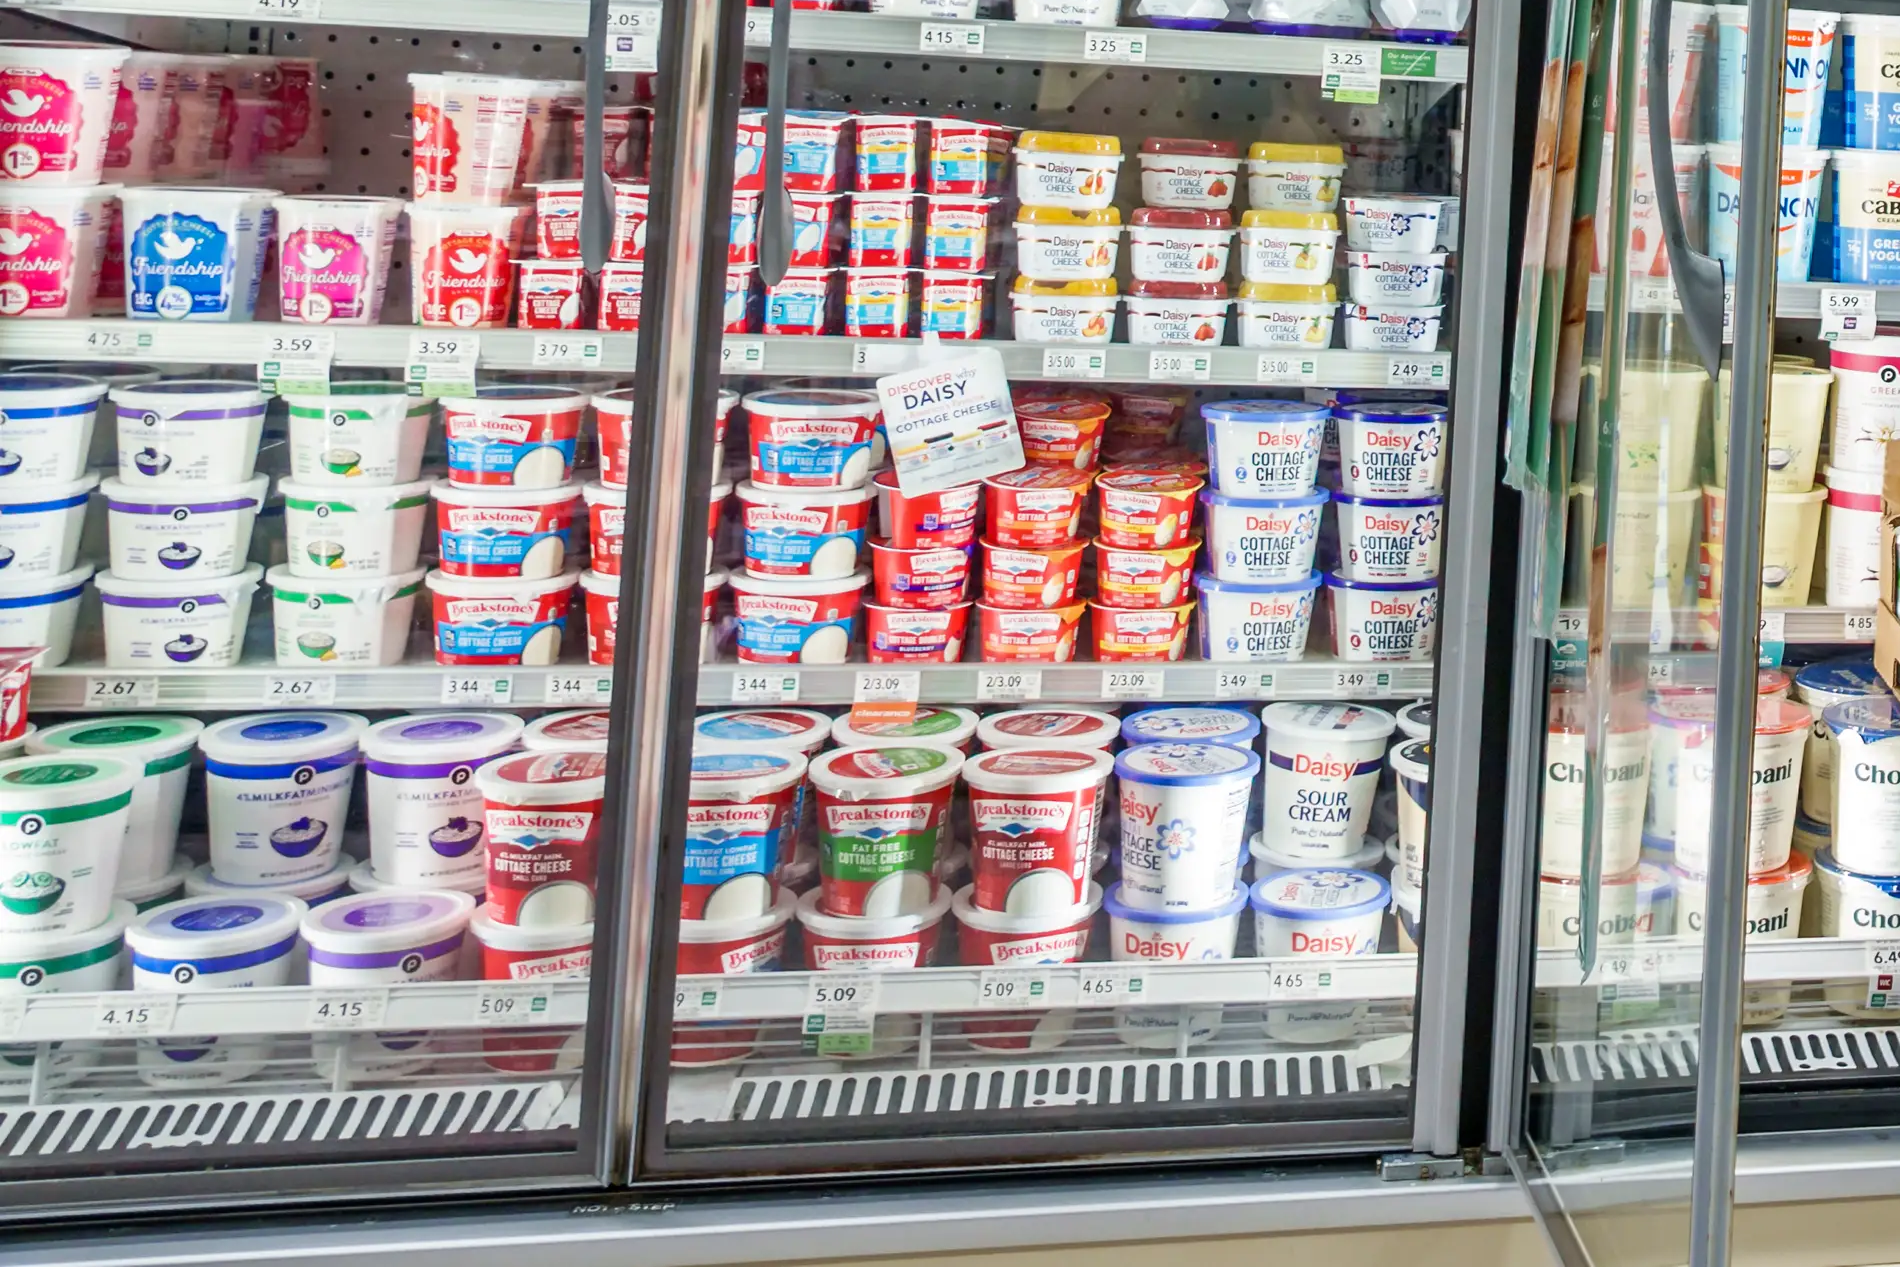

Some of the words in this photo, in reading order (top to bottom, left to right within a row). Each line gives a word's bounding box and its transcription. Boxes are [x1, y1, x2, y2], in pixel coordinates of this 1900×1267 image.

[1330, 52, 1363, 66] 3.25
[133, 256, 224, 277] Friendship
[283, 264, 361, 285] Friendship
[1829, 294, 1860, 310] 5.99
[272, 337, 312, 352] 3.59
[418, 341, 457, 355] 3.59
[887, 373, 951, 396] DISCOVER
[956, 368, 976, 379] why
[904, 380, 967, 410] DAISY
[896, 413, 950, 433] COTTAGE
[953, 400, 998, 418] CHEESE
[775, 422, 854, 436] Breakstone's
[1367, 430, 1411, 449] Daisy
[1362, 451, 1417, 467] COTTAGE
[1366, 466, 1412, 482] CHEESE
[1240, 536, 1296, 552] COTTAGE
[1244, 551, 1291, 566] CHEESE
[451, 601, 534, 615] Breakstone's
[95, 681, 137, 695] 2.67
[273, 681, 313, 695] 2.67
[863, 677, 900, 691] 2/3.09
[986, 675, 1022, 689] 2/3.09
[1110, 674, 1145, 687] 2/3.09
[1296, 789, 1348, 806] SOUR
[831, 805, 929, 822] Breakstone's
[976, 802, 1064, 818] Breakstone's
[1288, 805, 1351, 822] CREAM
[490, 814, 584, 831] Breakstone's
[852, 843, 871, 852] FAT
[873, 842, 901, 852] FREE
[1019, 847, 1054, 861] CHEESE
[838, 850, 876, 865] COTTAGE
[533, 859, 572, 874] CHEESE
[815, 987, 856, 1002] 5.09
[102, 1009, 149, 1025] 4.15
[317, 1002, 362, 1017] 4.15
